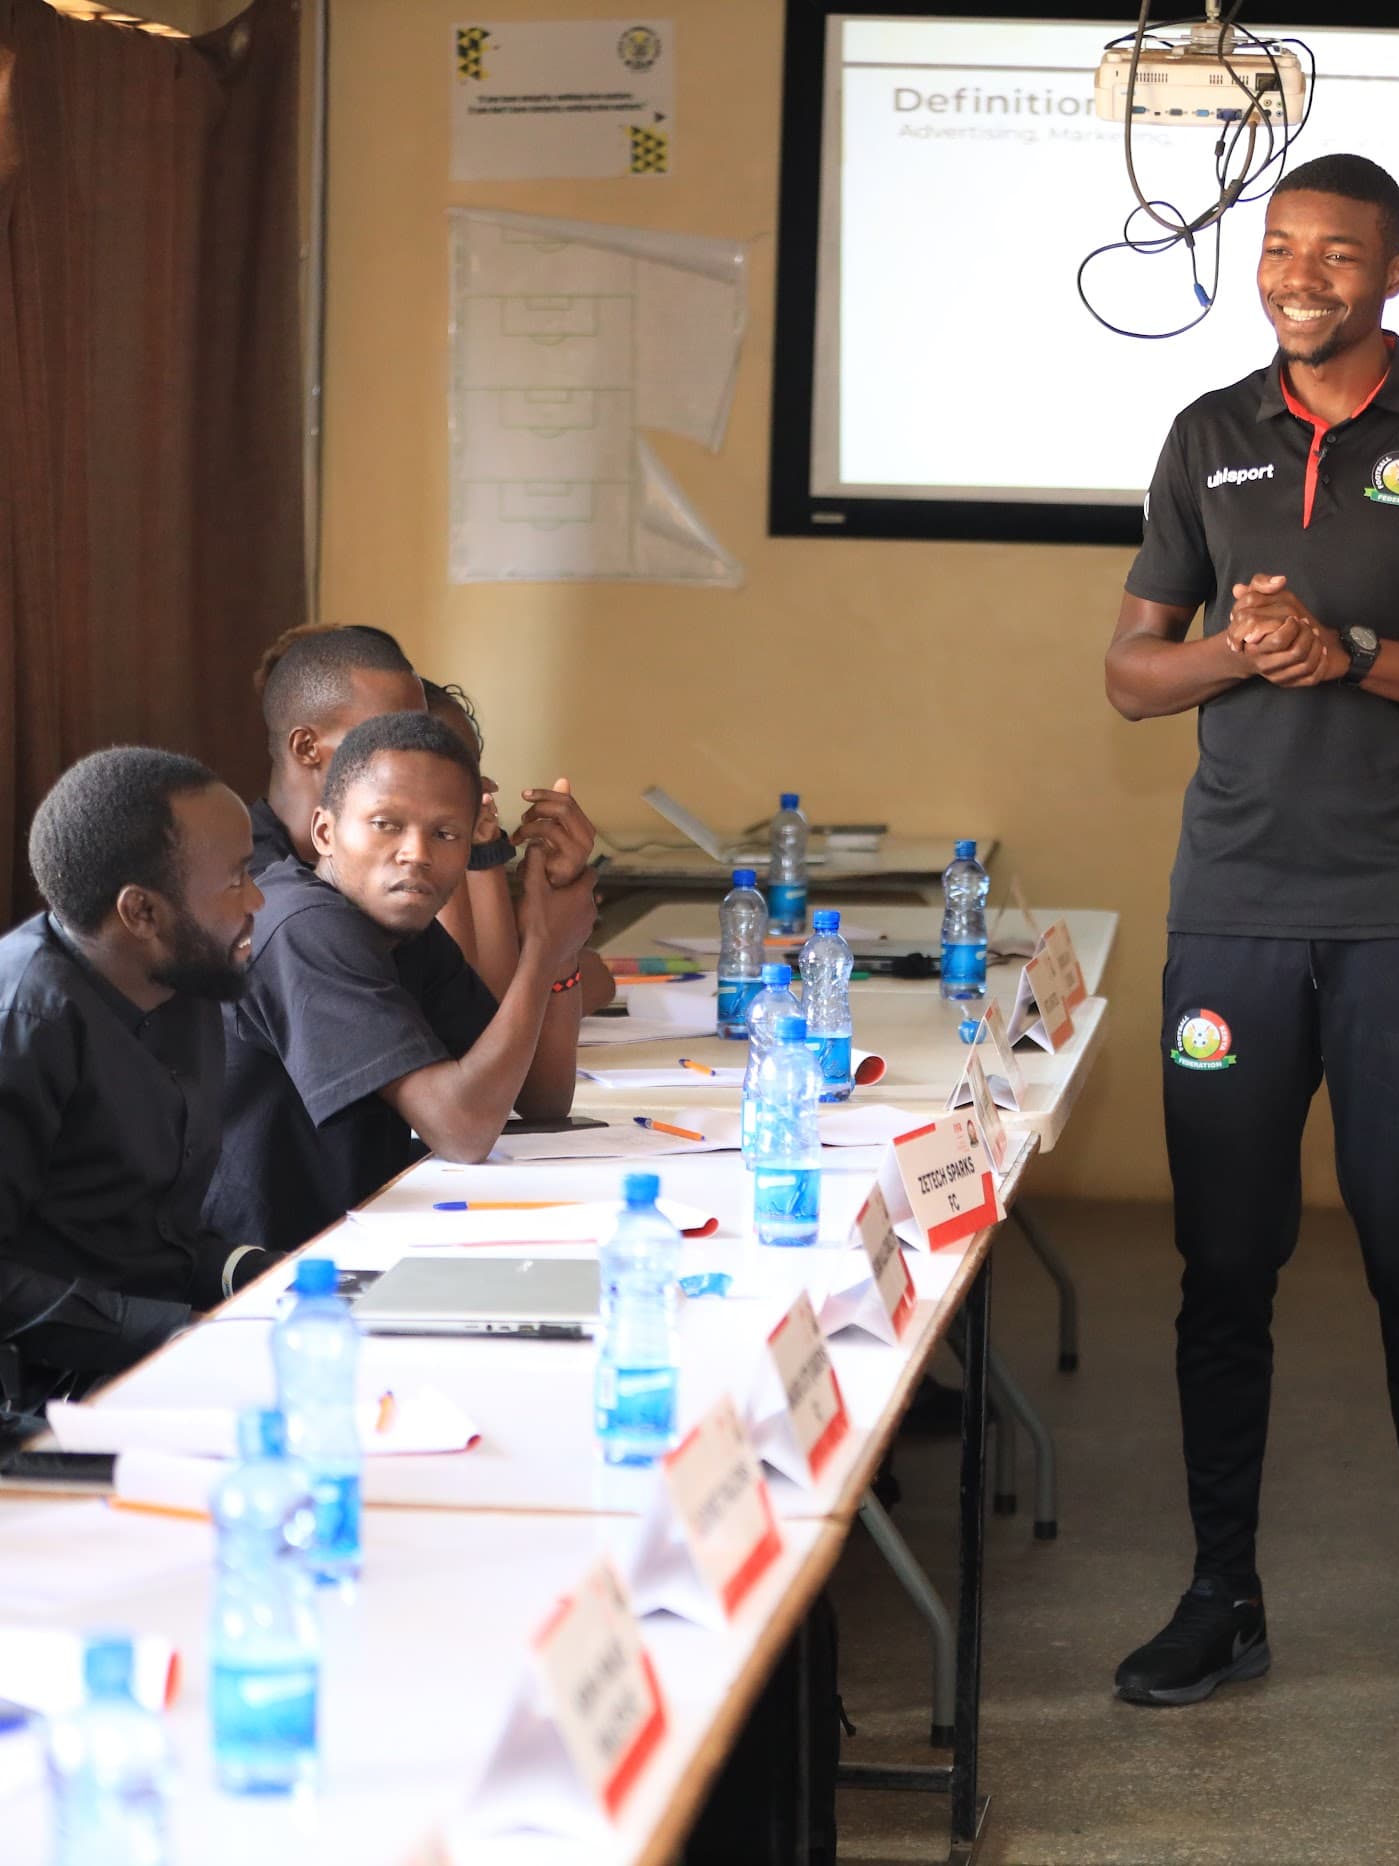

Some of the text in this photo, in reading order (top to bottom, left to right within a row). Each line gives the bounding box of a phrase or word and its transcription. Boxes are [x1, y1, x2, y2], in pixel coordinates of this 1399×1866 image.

[1207, 463, 1274, 488] uhlsport
[918, 1156, 975, 1194] ZETECH SPARKS
[948, 1193, 960, 1213] FC
